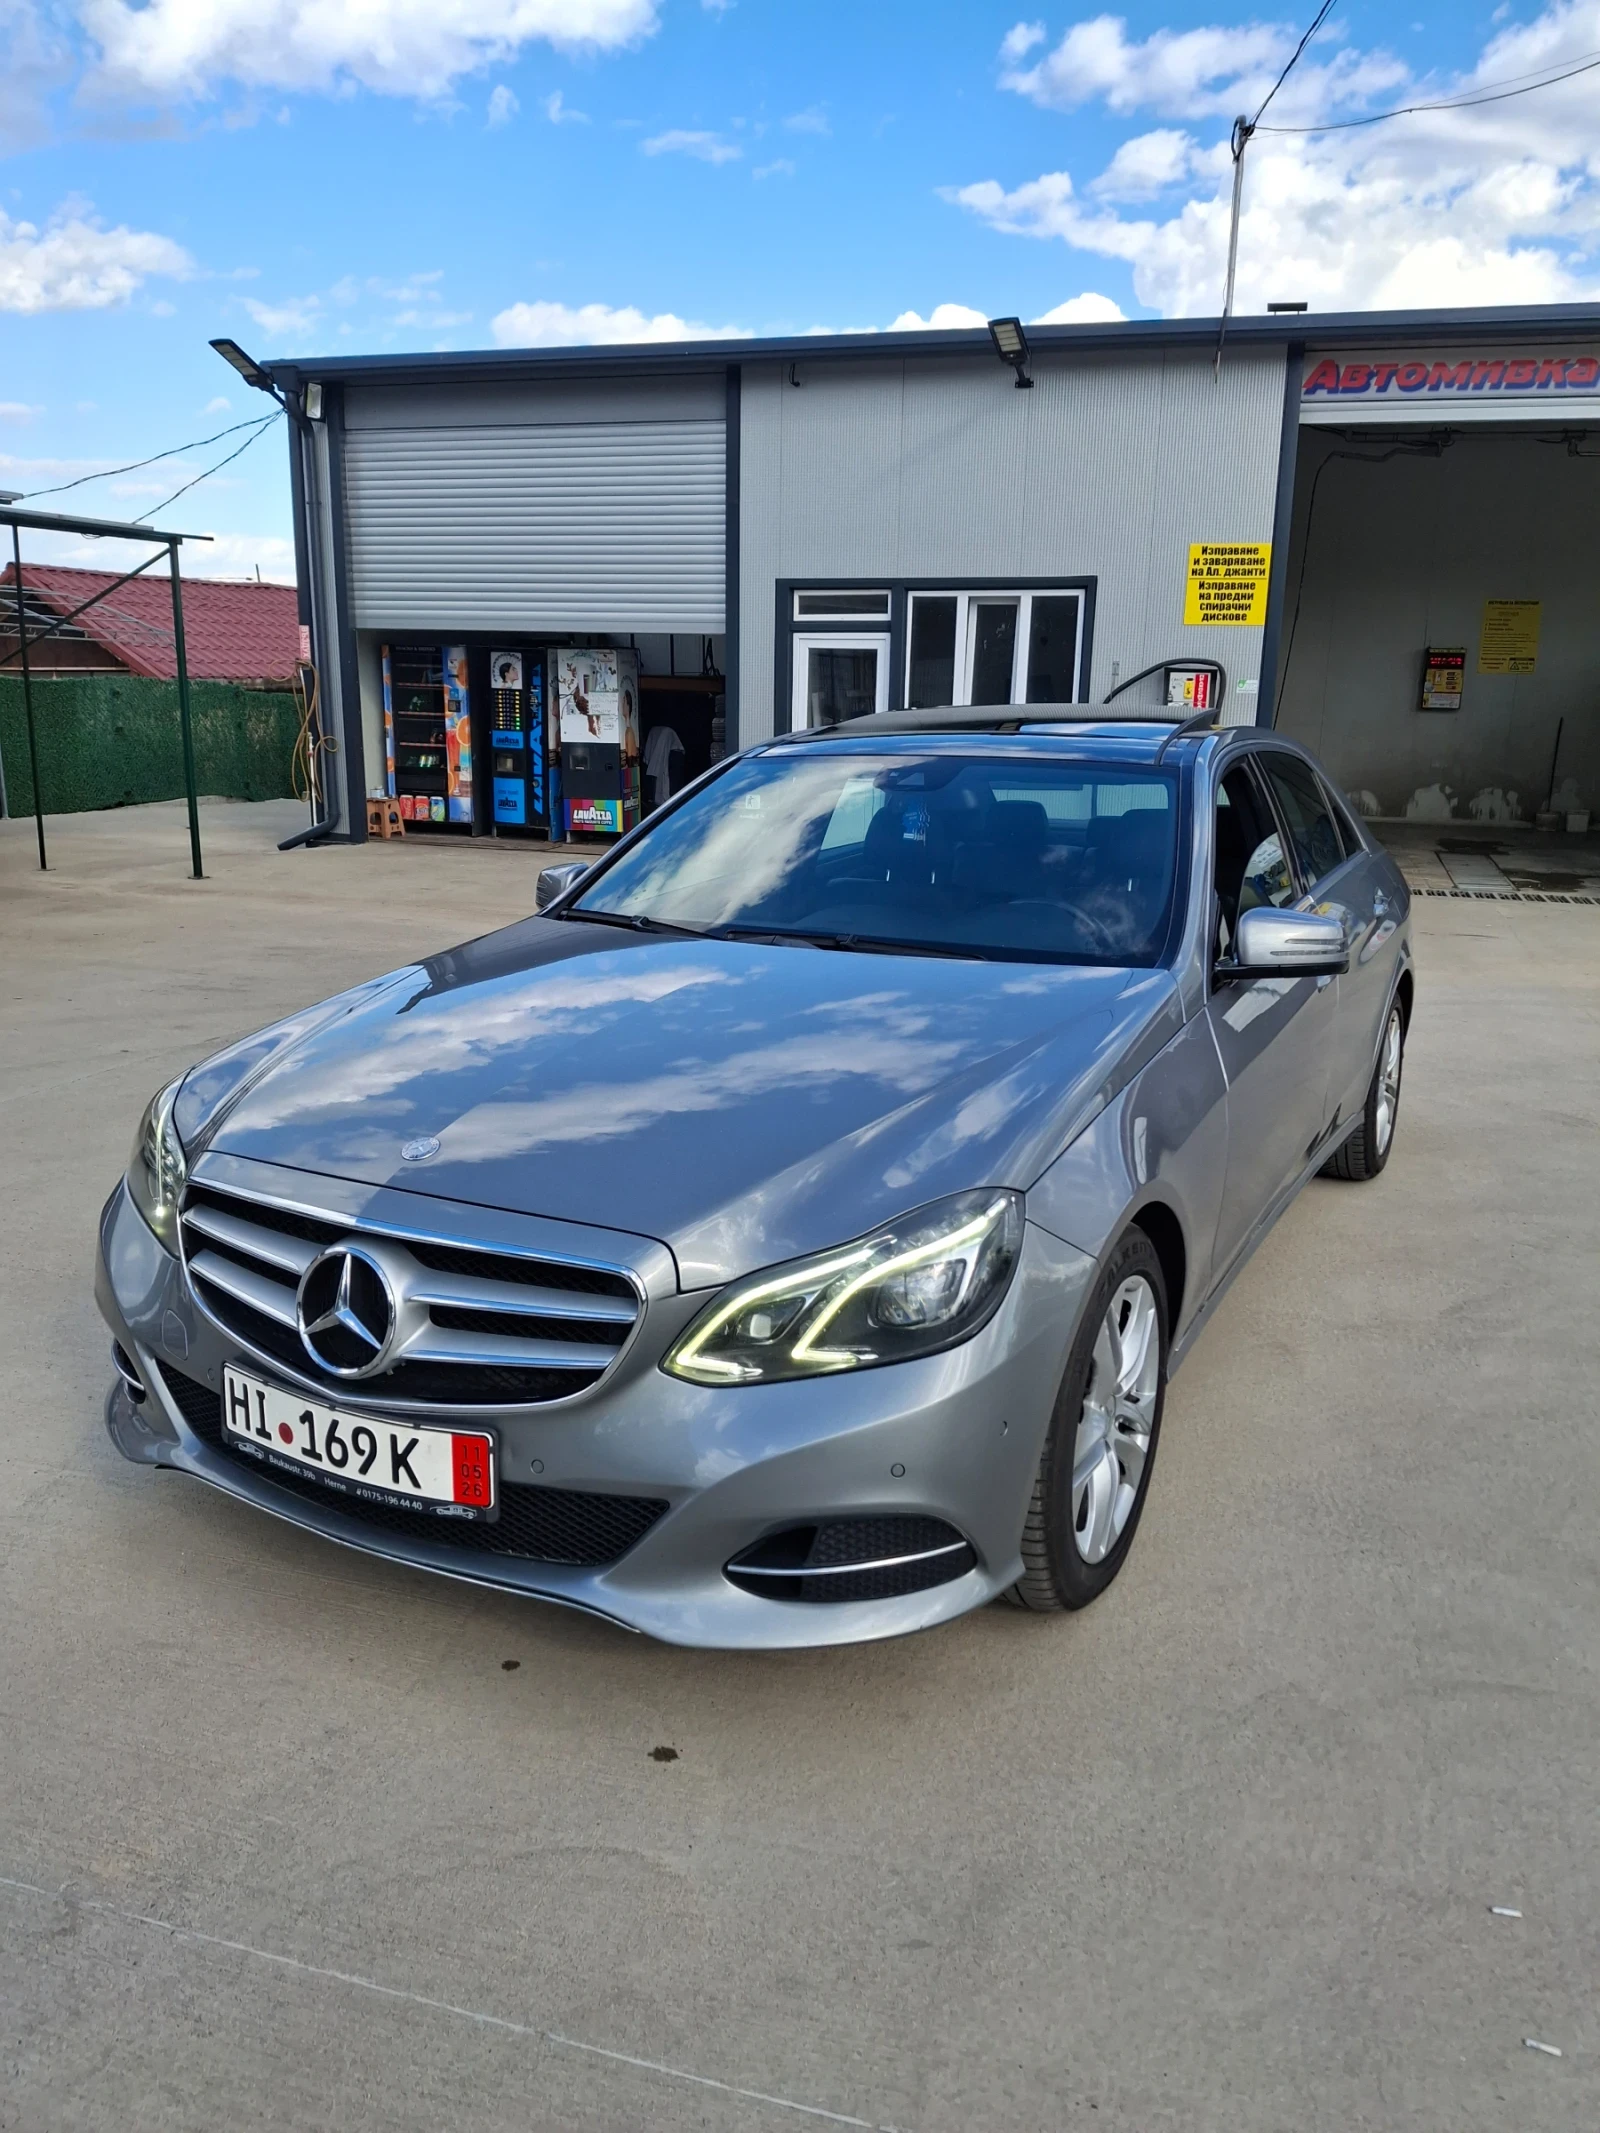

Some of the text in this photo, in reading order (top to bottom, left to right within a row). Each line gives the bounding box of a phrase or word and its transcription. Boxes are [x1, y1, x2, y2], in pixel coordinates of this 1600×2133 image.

[1201, 545, 1259, 556] Изправяне
[1193, 557, 1266, 567] и заваряване
[1191, 566, 1266, 577] на Ал. джанти
[1198, 580, 1256, 591] Изправяне
[1198, 592, 1254, 601] на предни
[1199, 602, 1251, 612] спирачни
[1201, 612, 1247, 622] дискове
[573, 806, 613, 821] LAVAZZA
[229, 1377, 273, 1441] HI
[462, 1445, 480, 1461] 11
[461, 1463, 482, 1479] 05
[323, 1476, 347, 1492] Herne
[362, 1489, 399, 1505] 0175-196
[400, 1498, 410, 1508] 44
[411, 1500, 423, 1511] 40
[461, 1481, 482, 1498] 26
